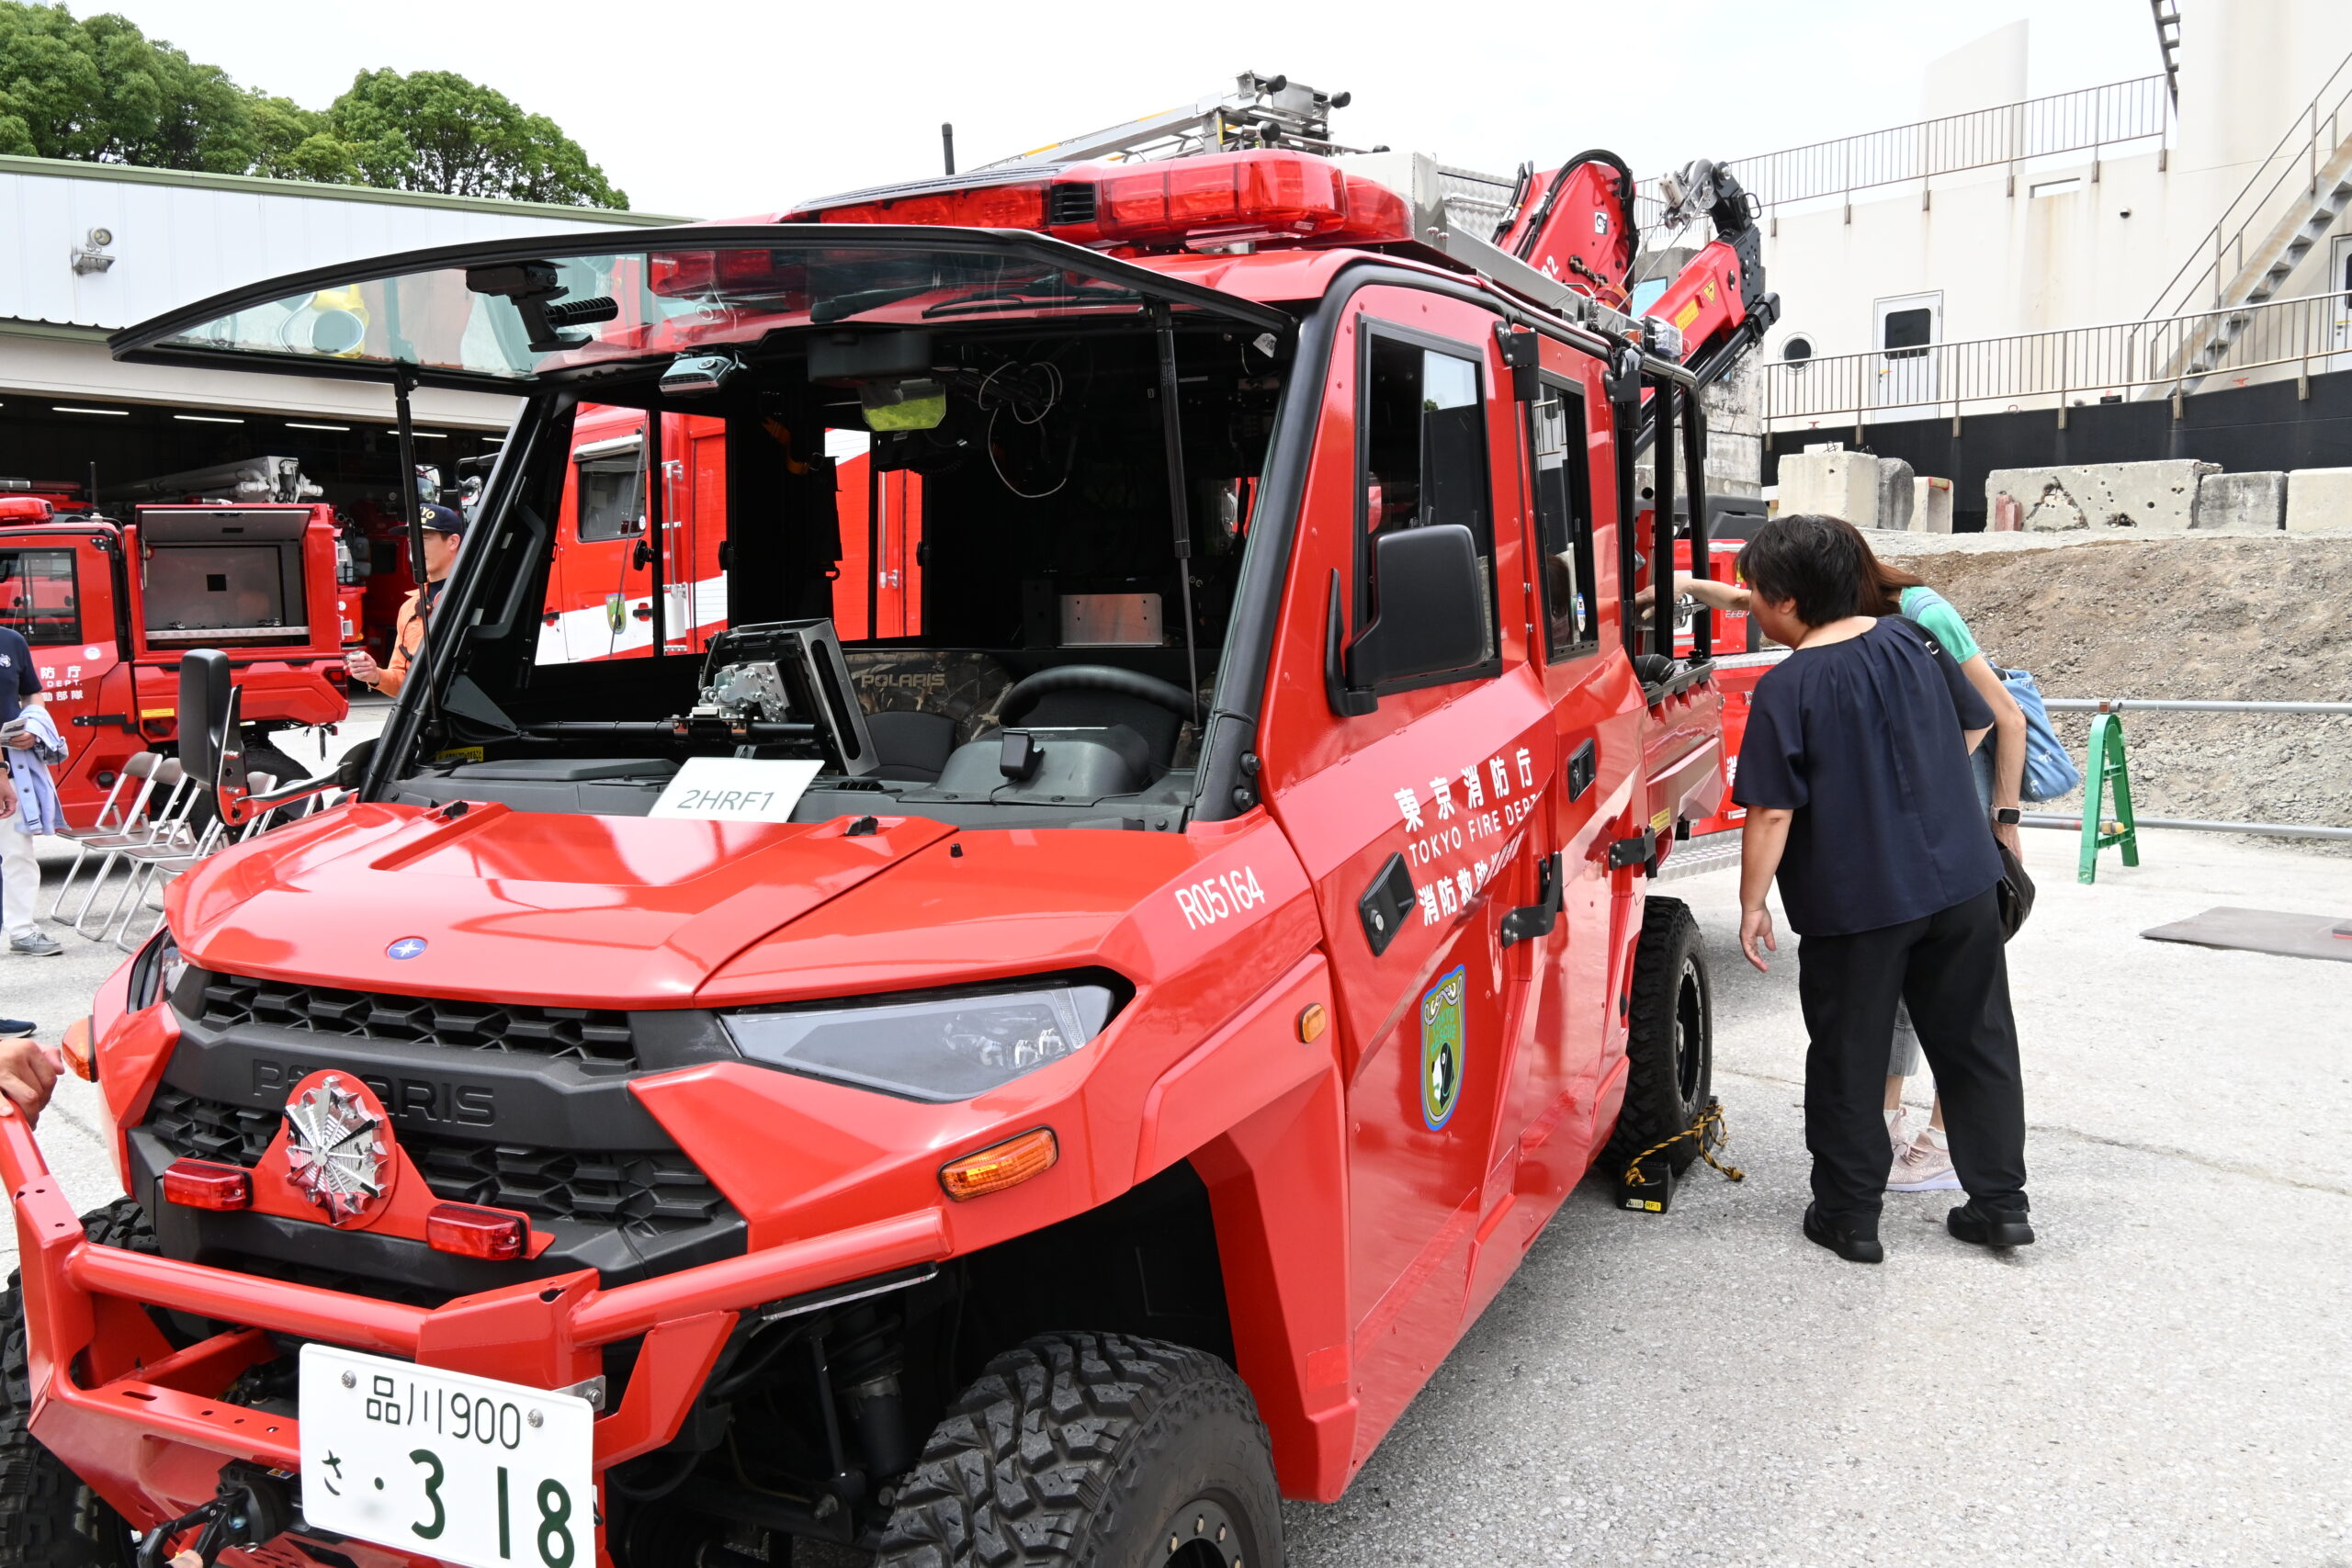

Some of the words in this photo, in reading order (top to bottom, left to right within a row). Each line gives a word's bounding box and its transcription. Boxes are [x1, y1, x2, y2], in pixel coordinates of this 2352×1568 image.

[861, 673, 945, 687] POLARIS
[677, 789, 775, 811] 2HRF1
[1394, 748, 1533, 833] 東京消防庁
[1408, 827, 1461, 867] TOKYO
[1468, 810, 1501, 841] FIRE
[1175, 865, 1265, 931] R05164
[253, 1059, 496, 1128] PARIS
